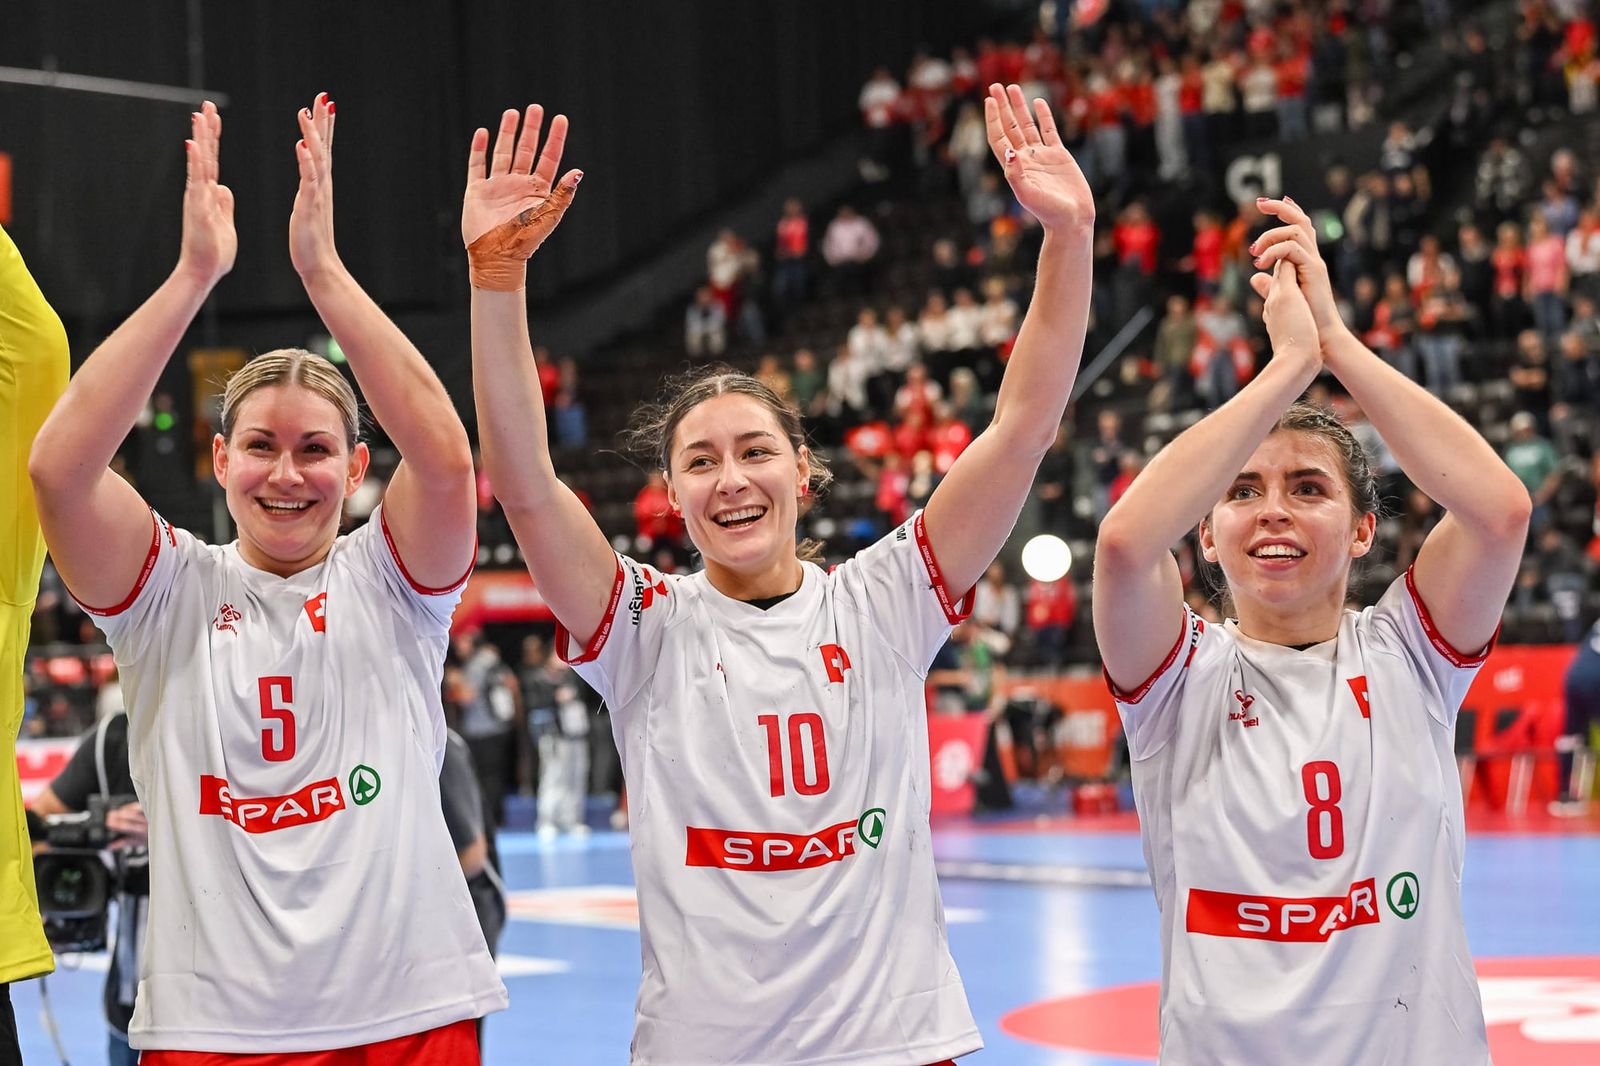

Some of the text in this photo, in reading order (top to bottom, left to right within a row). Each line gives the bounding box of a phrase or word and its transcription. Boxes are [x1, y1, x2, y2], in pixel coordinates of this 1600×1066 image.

[258, 675, 296, 762] 5
[757, 712, 831, 798] 10
[218, 785, 340, 827] SPAR
[1301, 760, 1344, 860] 8
[1237, 886, 1375, 935] SPAR
